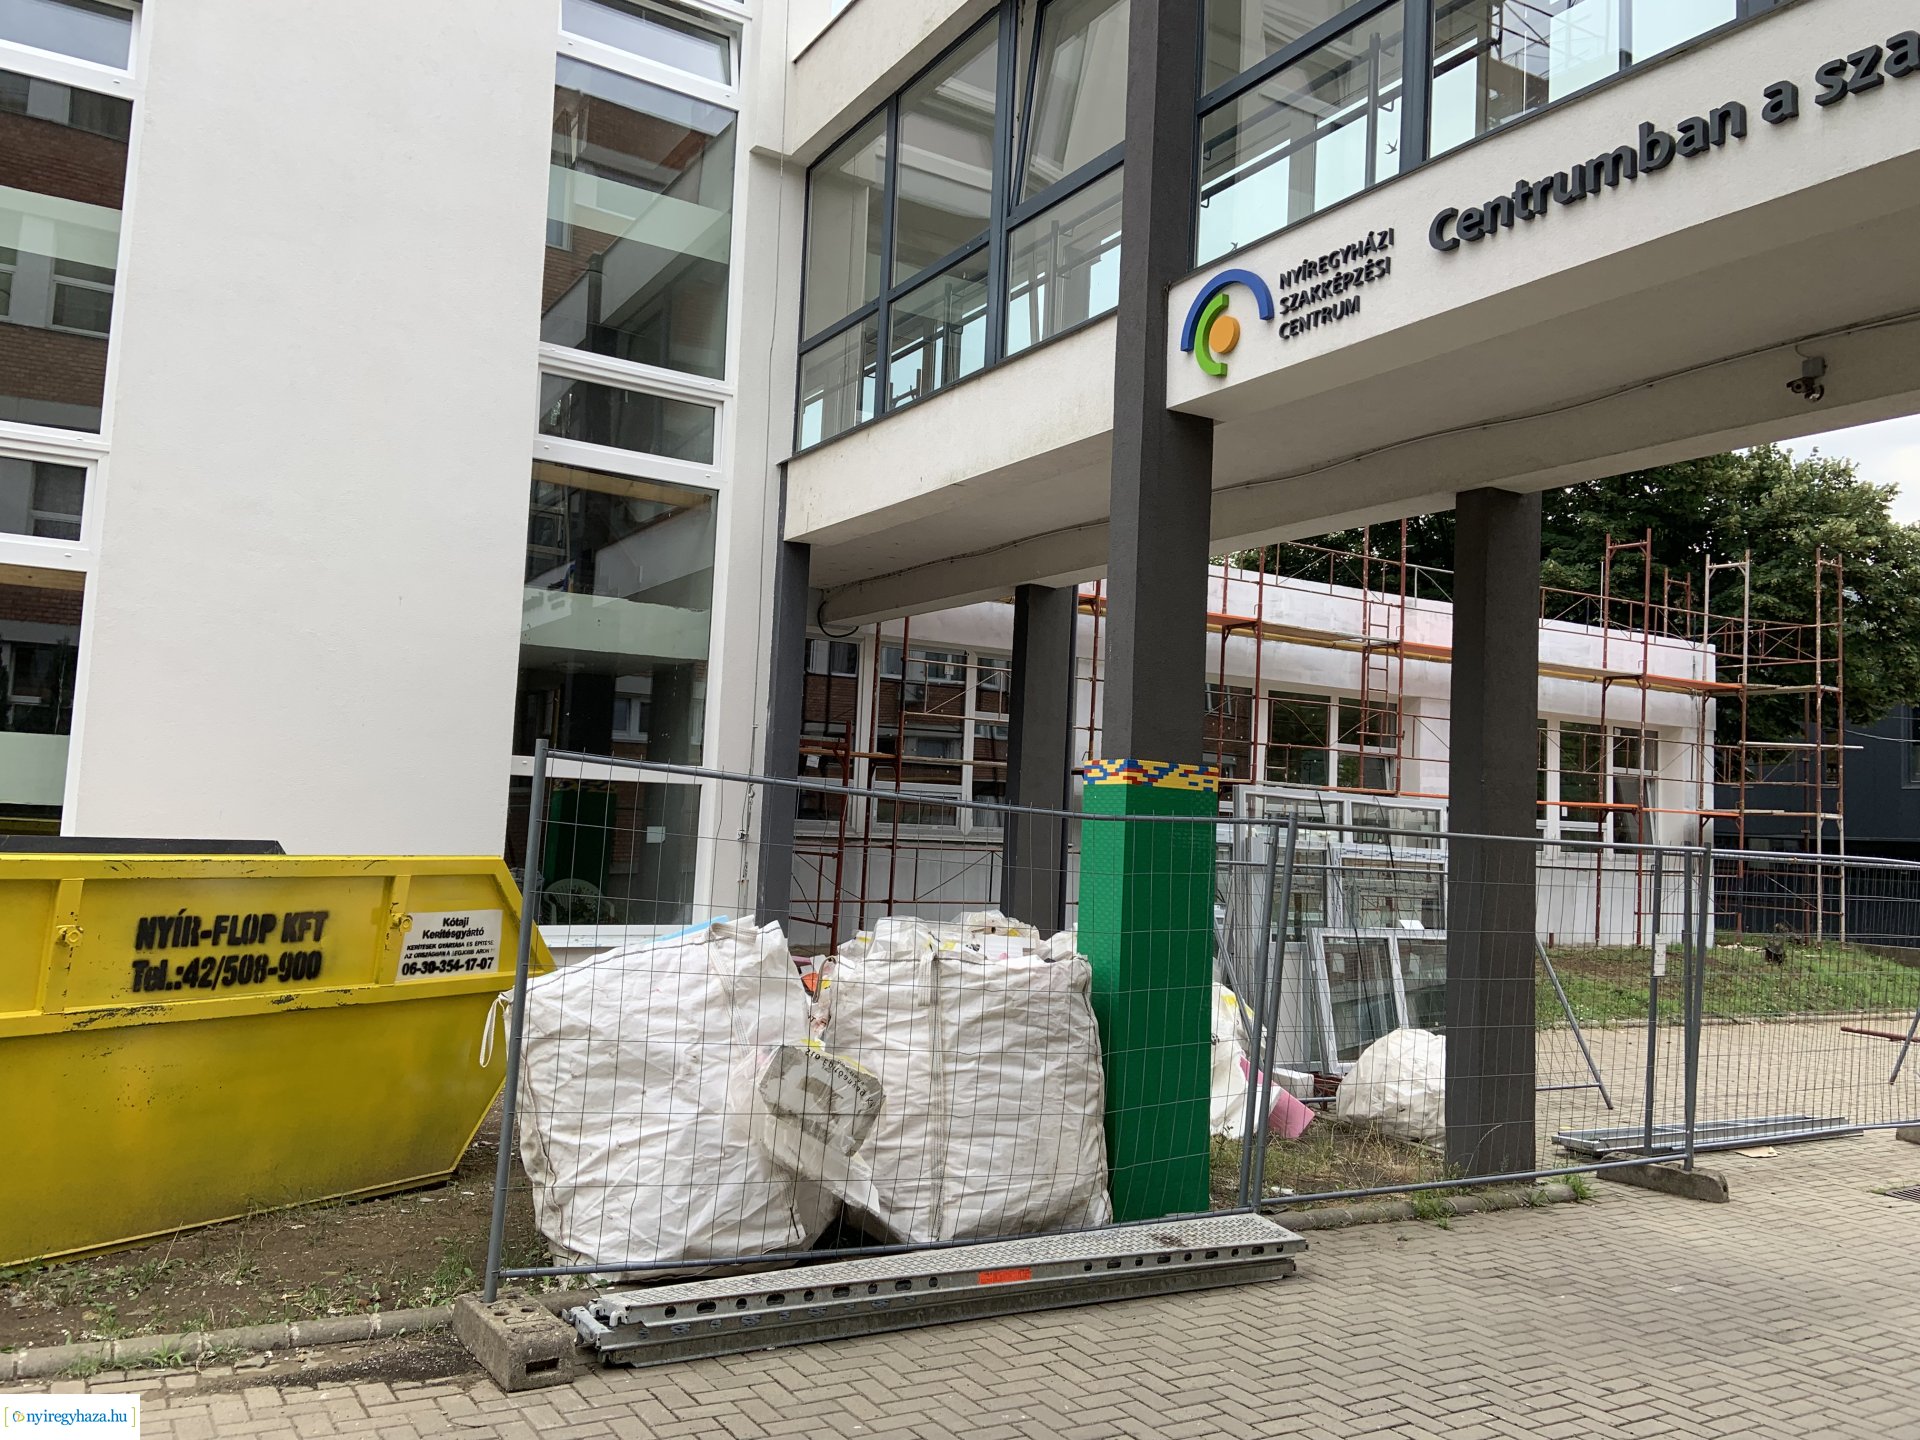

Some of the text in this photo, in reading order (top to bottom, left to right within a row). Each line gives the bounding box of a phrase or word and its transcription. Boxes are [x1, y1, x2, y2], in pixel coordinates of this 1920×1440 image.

[1428, 100, 1747, 252] Centrumban
[1761, 79, 1800, 125] a
[1279, 227, 1395, 290] NYÍREGYHÁZI
[1279, 256, 1391, 315] SZAKKÉPZÉSI
[1278, 295, 1361, 340] CENTRUM
[135, 908, 330, 951] NYÍR-FLOP KFT
[442, 916, 470, 929] Kótaji
